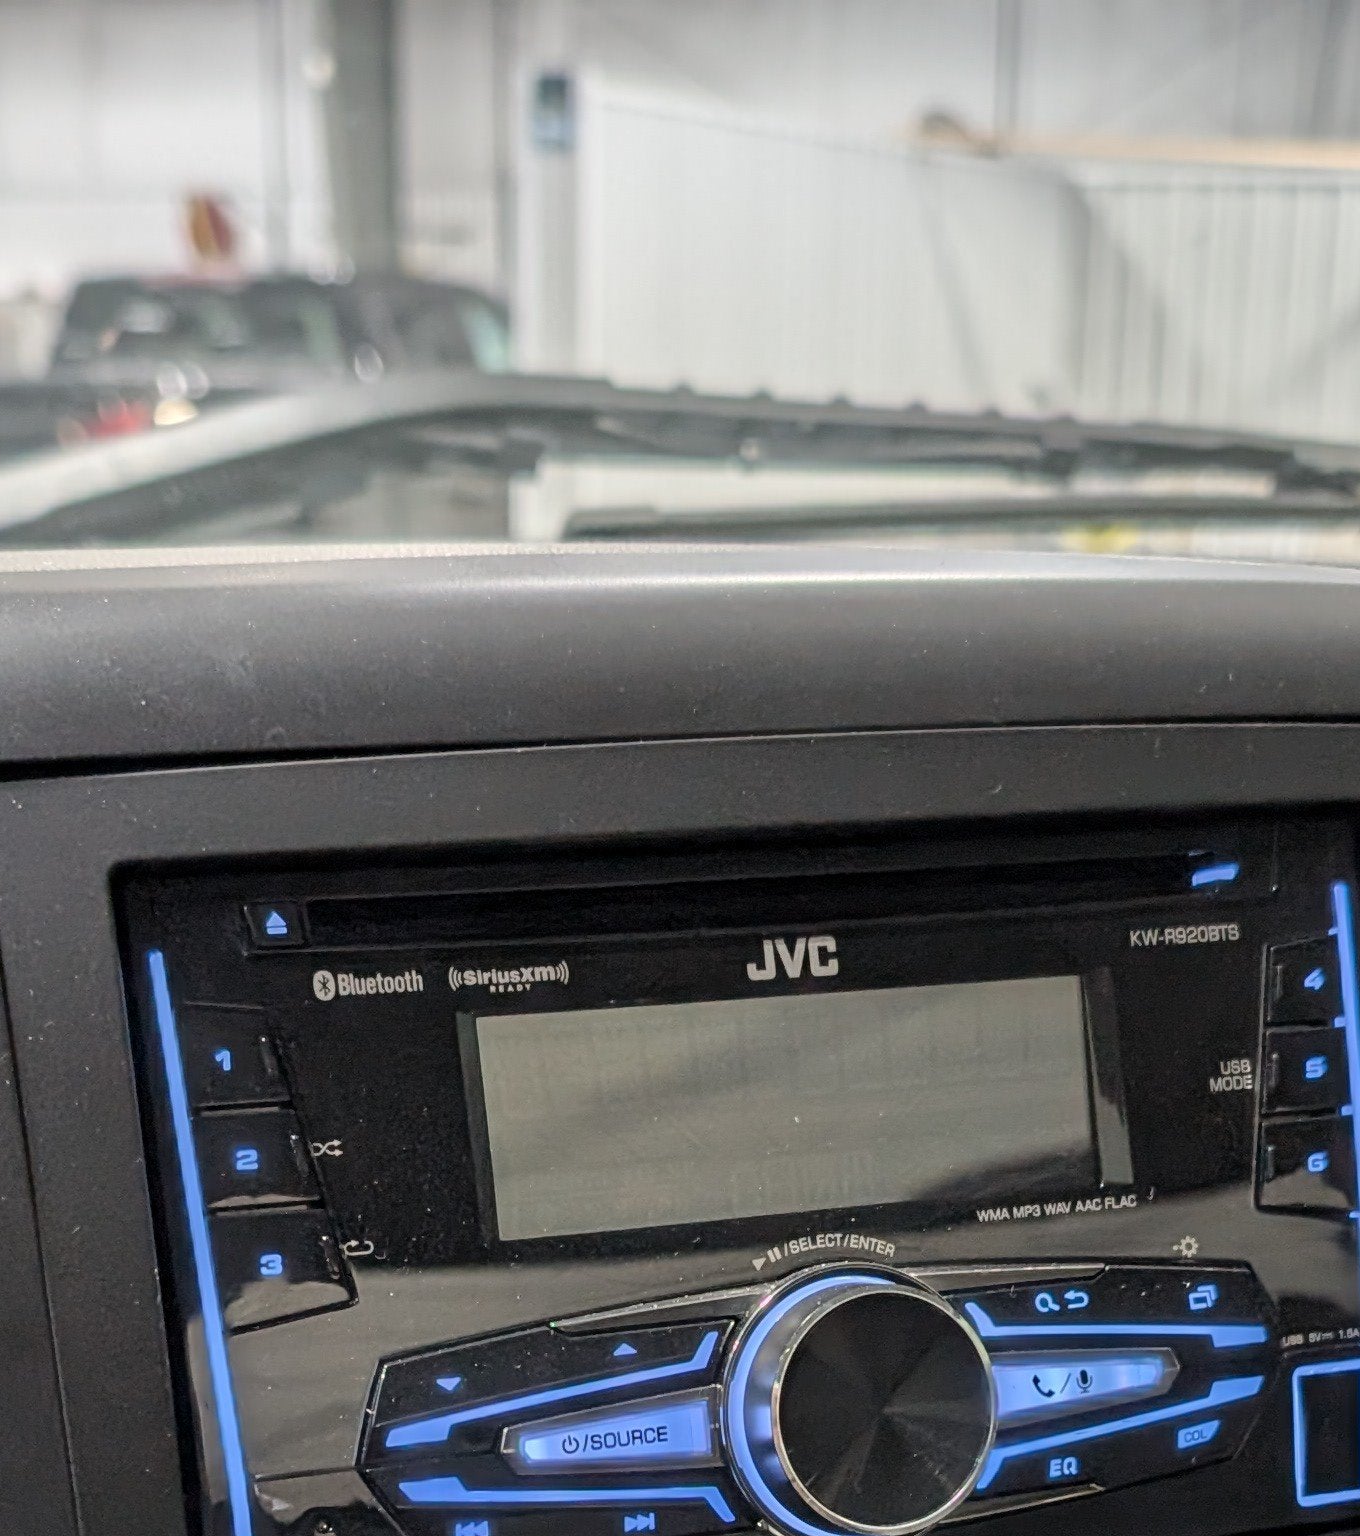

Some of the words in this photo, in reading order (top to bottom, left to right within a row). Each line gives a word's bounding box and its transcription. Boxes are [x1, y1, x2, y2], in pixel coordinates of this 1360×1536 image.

[746, 935, 840, 981] JVC
[337, 970, 424, 996] Bluetooth
[489, 983, 532, 994] READY
[1303, 967, 1326, 991] 4
[214, 1048, 232, 1072] 1
[1220, 1059, 1252, 1076] USB
[1305, 1055, 1327, 1080] 5
[1210, 1075, 1253, 1093] MODE
[236, 1149, 258, 1171] 2
[976, 1207, 1011, 1223] WMA
[1012, 1204, 1041, 1219] MP3
[1043, 1201, 1072, 1216] WAV
[1075, 1198, 1103, 1213] AAC
[1104, 1194, 1137, 1210] FLAC
[260, 1253, 283, 1276] 3
[1281, 1333, 1304, 1347] USB
[1183, 1429, 1207, 1442] COL
[1049, 1456, 1078, 1478] EQ
